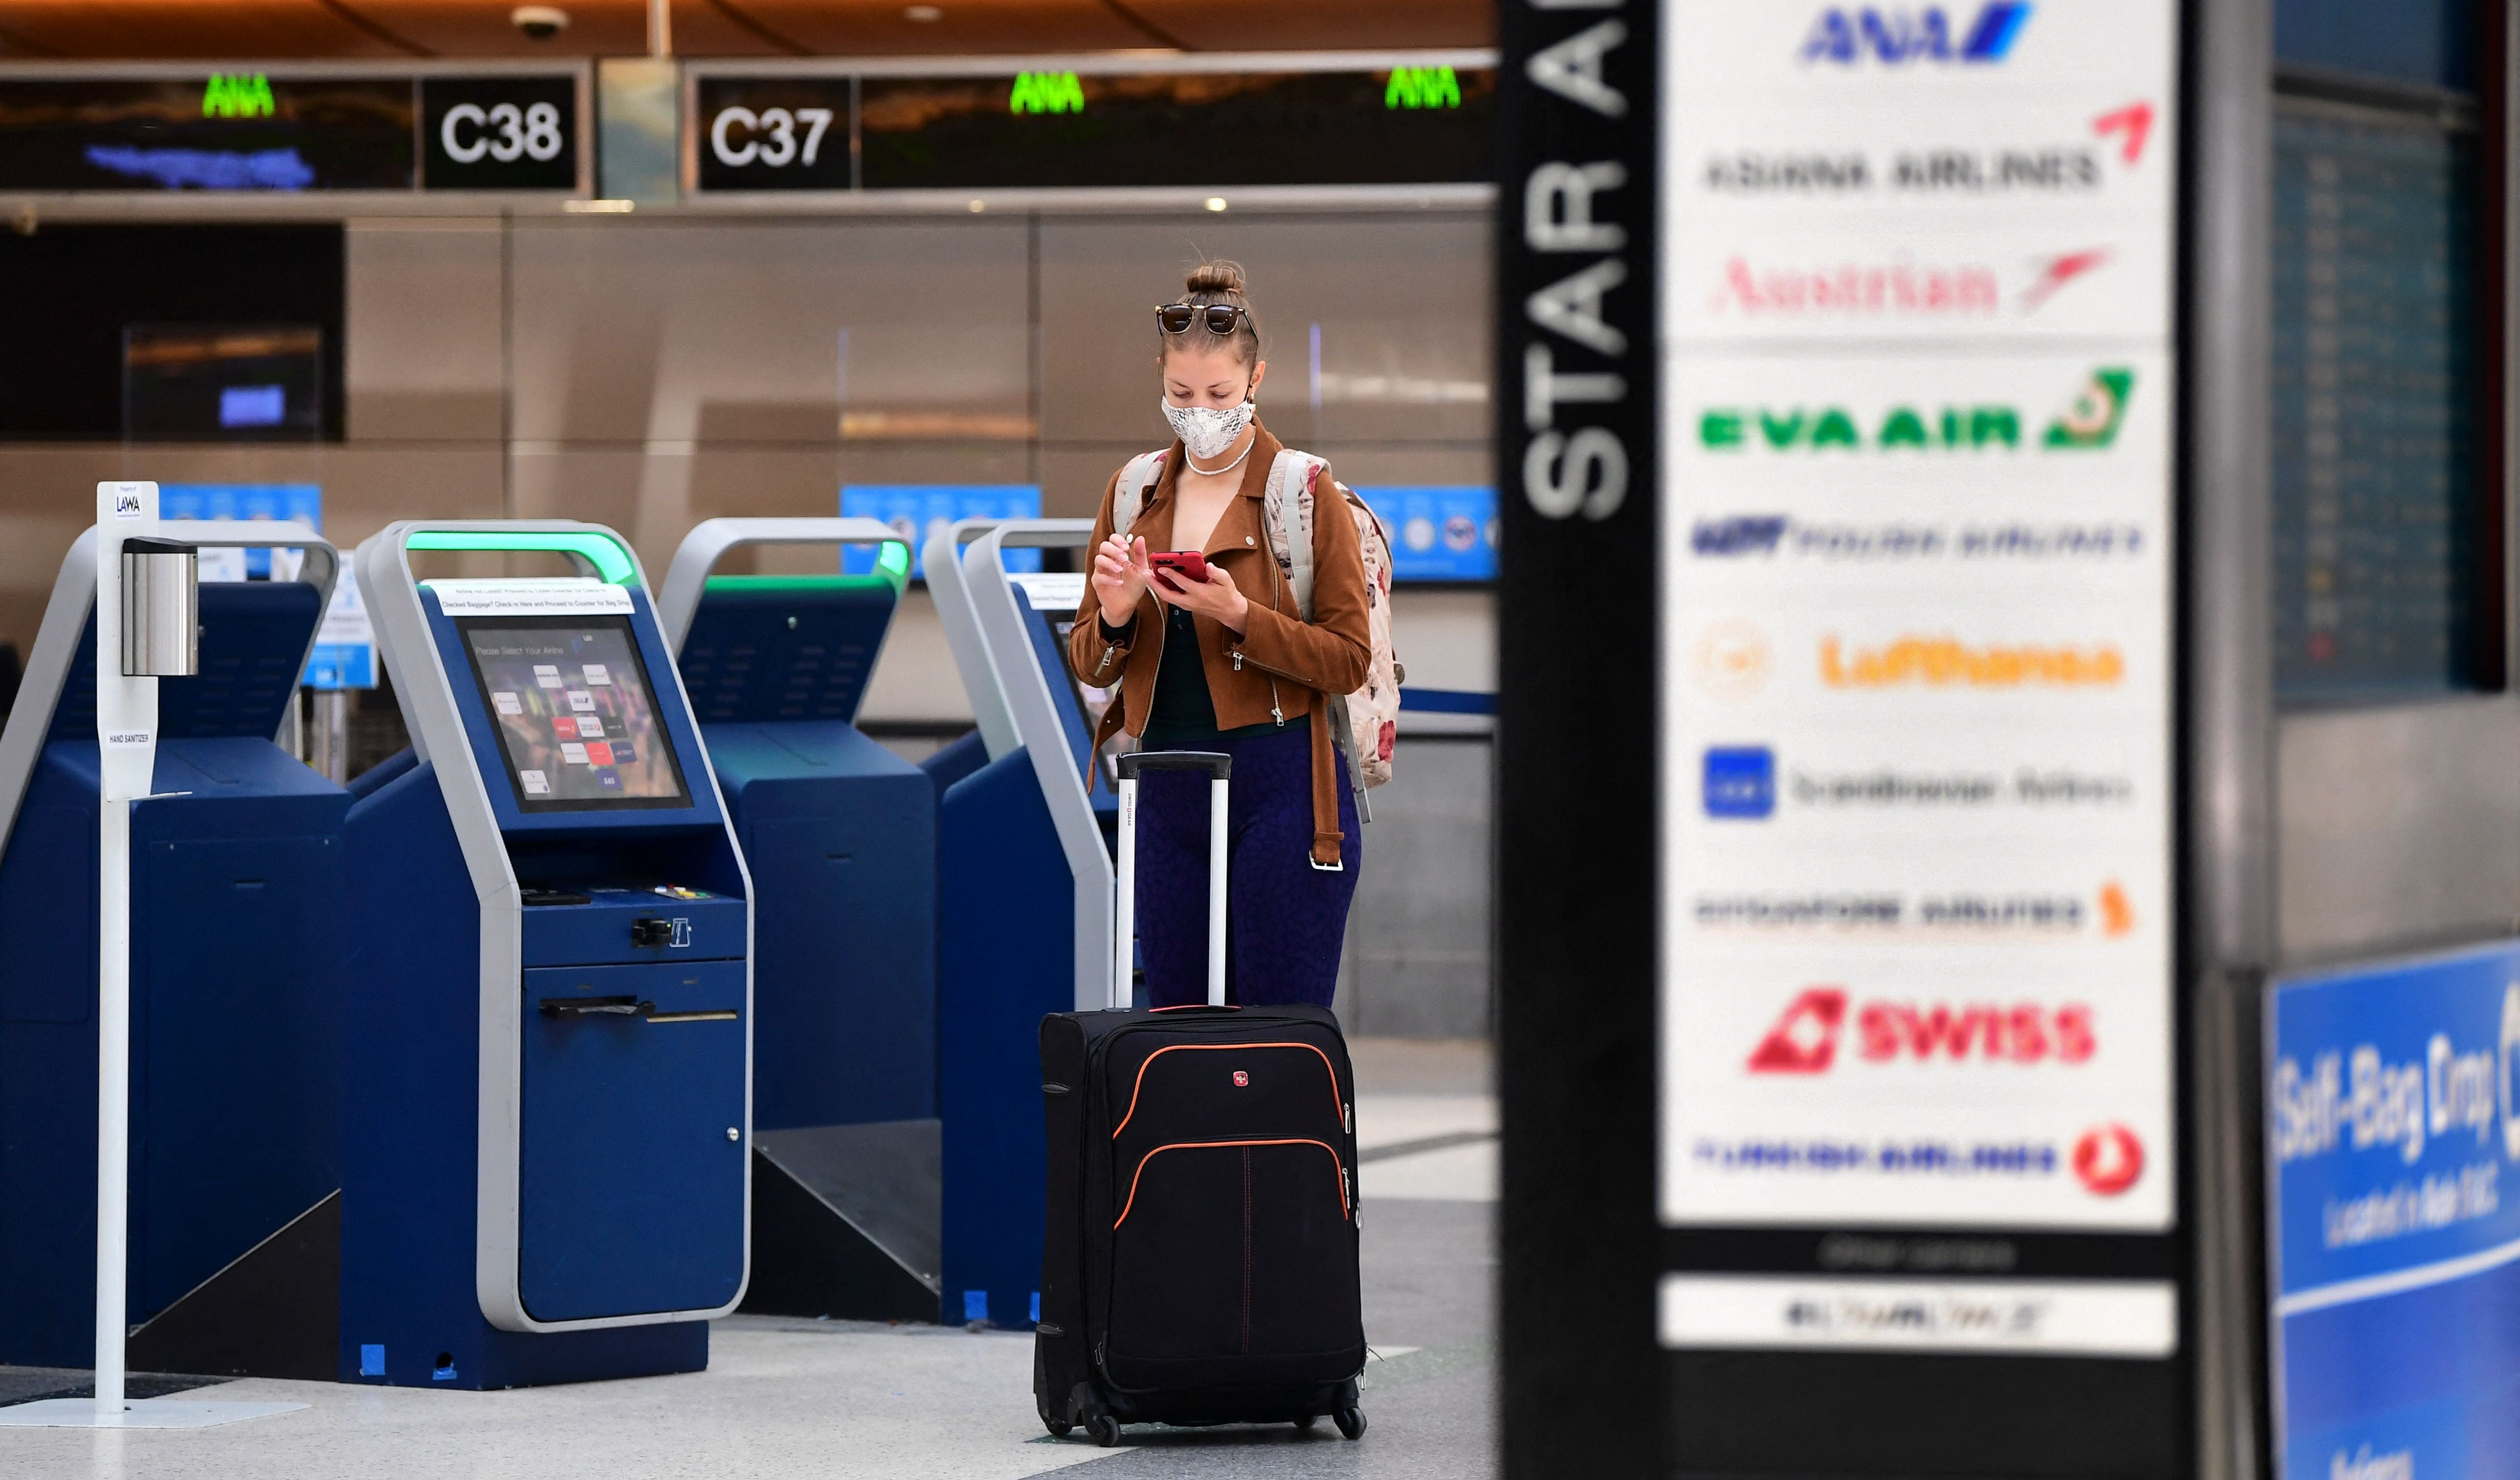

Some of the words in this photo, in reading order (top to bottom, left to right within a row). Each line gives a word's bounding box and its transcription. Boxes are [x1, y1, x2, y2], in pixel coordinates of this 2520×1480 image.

[1801, 6, 1955, 64] ANA
[1010, 71, 1084, 114] ANA
[1385, 65, 1461, 109] ANA
[441, 102, 562, 163] C38
[711, 106, 833, 167] C37
[1704, 152, 1873, 192] ASIANA
[1889, 149, 2100, 191] AIRLINES
[1709, 255, 1999, 316] Austrian
[1524, 161, 1628, 521] STAR
[1698, 407, 1861, 452] EVA
[1876, 407, 2022, 452] AIR
[117, 496, 140, 512] LAWA
[1956, 522, 2144, 559] AIRLINES
[475, 646, 499, 655] Please
[500, 646, 522, 655] Select
[524, 646, 541, 655] Your
[1819, 633, 2124, 693] Lufthansa
[109, 734, 124, 743] HAND
[124, 734, 149, 743] SANITIZER
[1919, 895, 2084, 925] AIRLINES
[1856, 1003, 2096, 1064] SWISS
[2271, 1046, 2423, 1164] Self-Bag
[2427, 1033, 2495, 1147] Drop
[1694, 1140, 1869, 1175] TURKISH
[1877, 1142, 2059, 1176] AIRLINES
